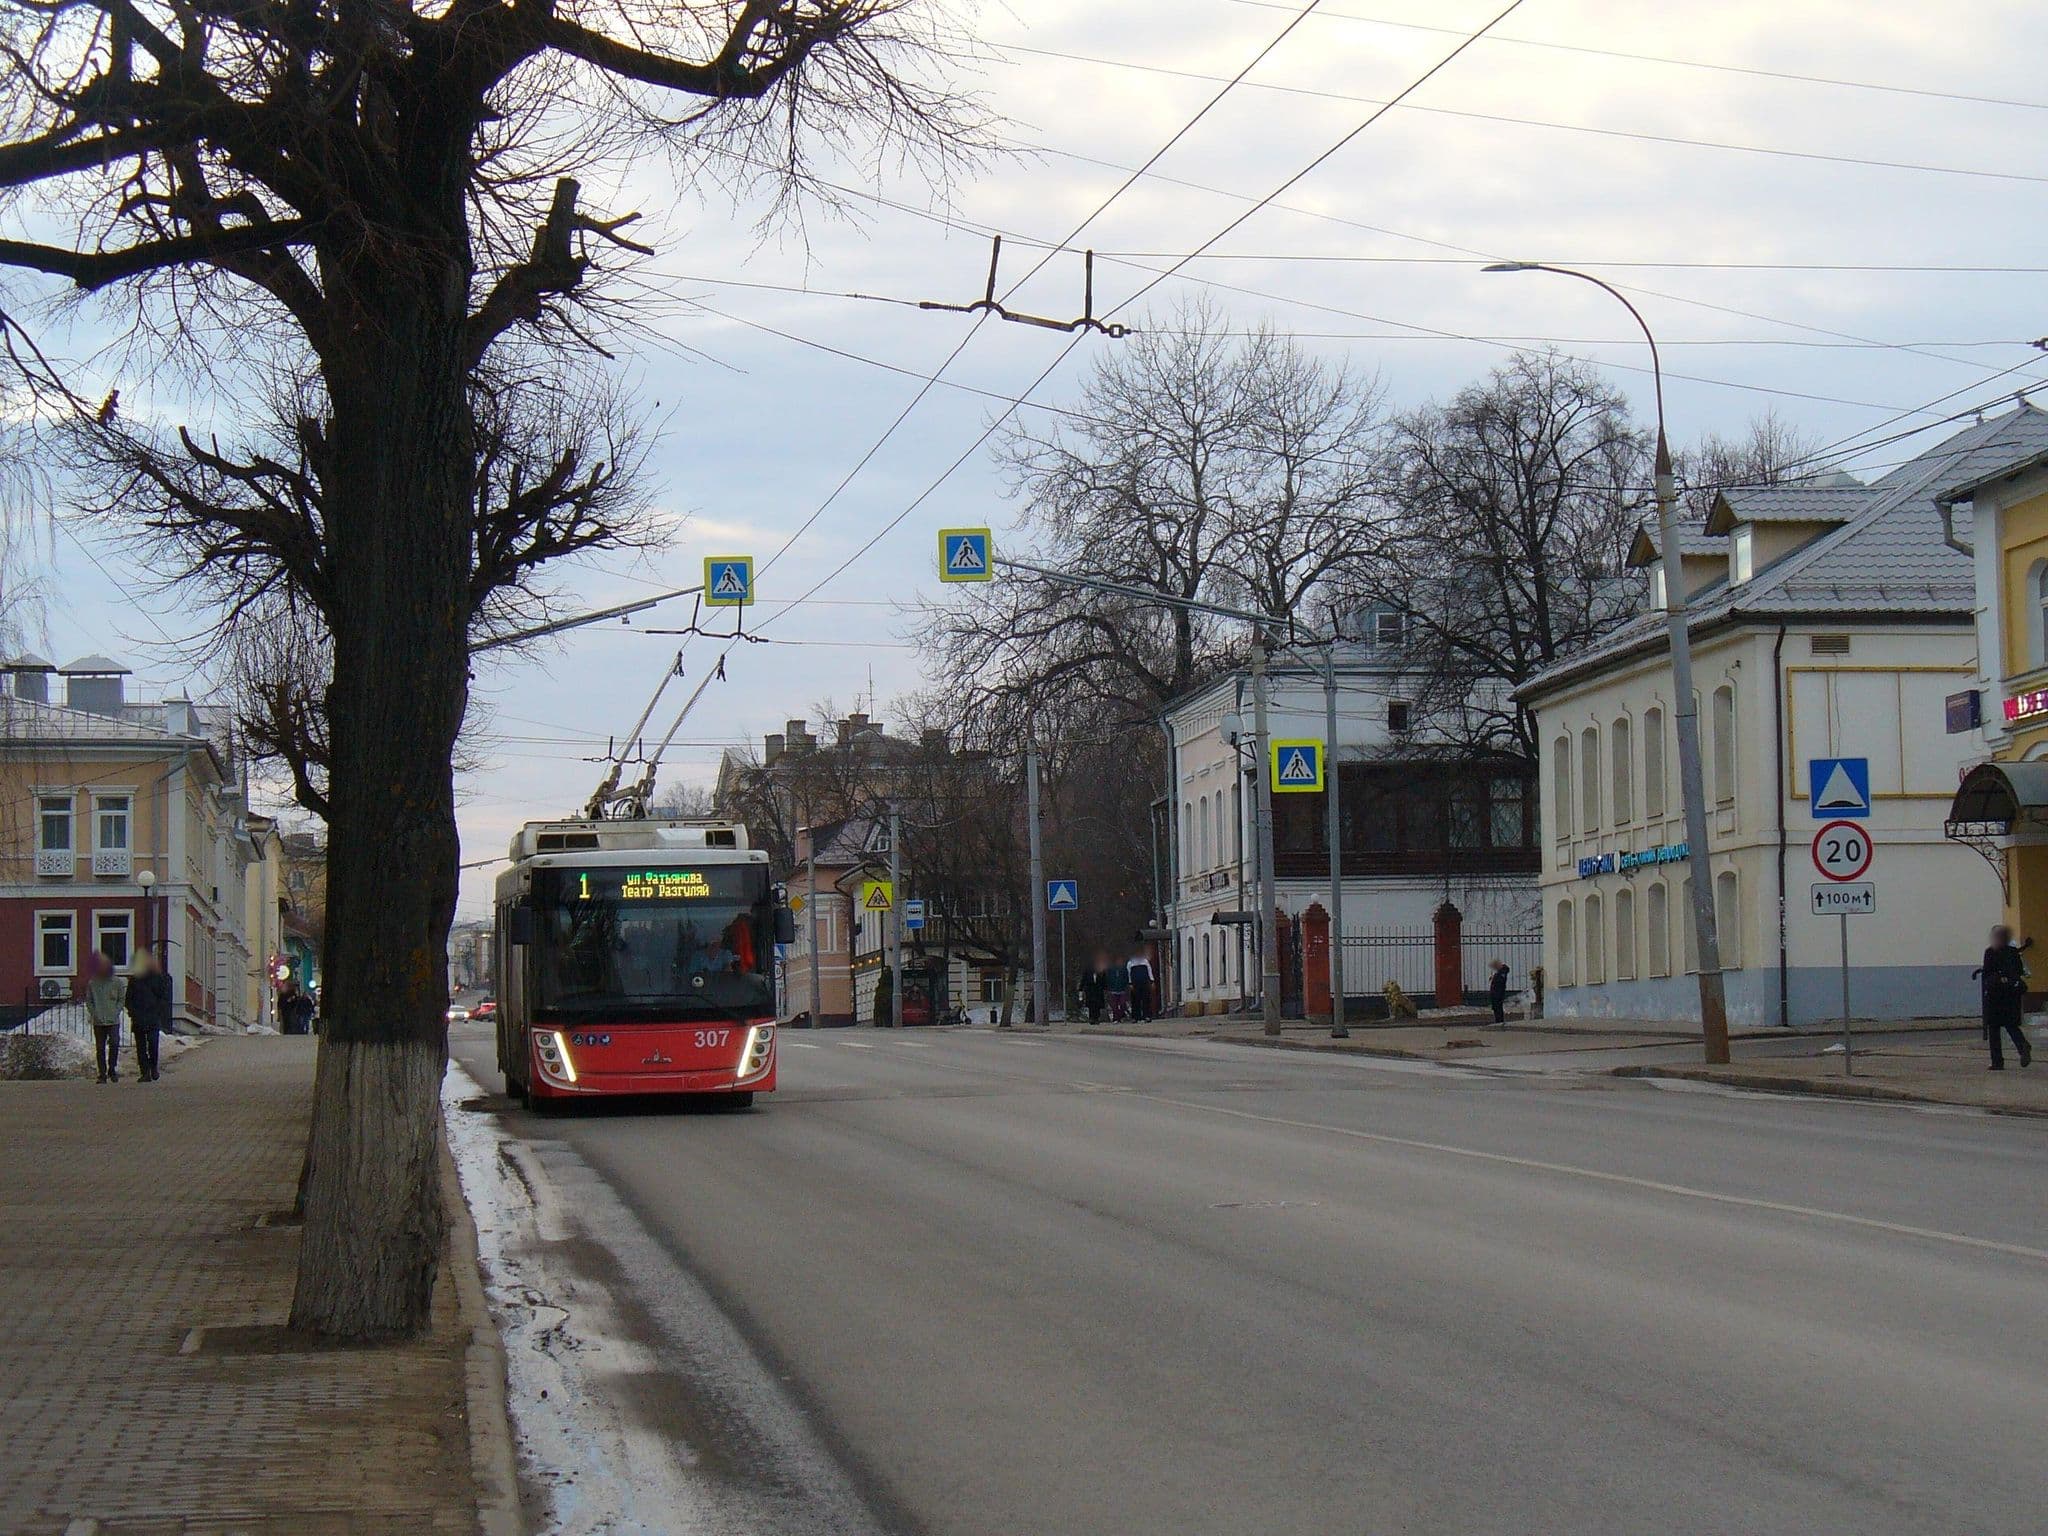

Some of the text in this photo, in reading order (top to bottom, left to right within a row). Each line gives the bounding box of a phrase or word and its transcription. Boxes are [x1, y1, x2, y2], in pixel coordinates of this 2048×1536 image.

[1826, 839, 1861, 863] 20
[579, 872, 590, 898] 1
[621, 884, 709, 898] Театр Разгуляй
[694, 1030, 730, 1048] 307
